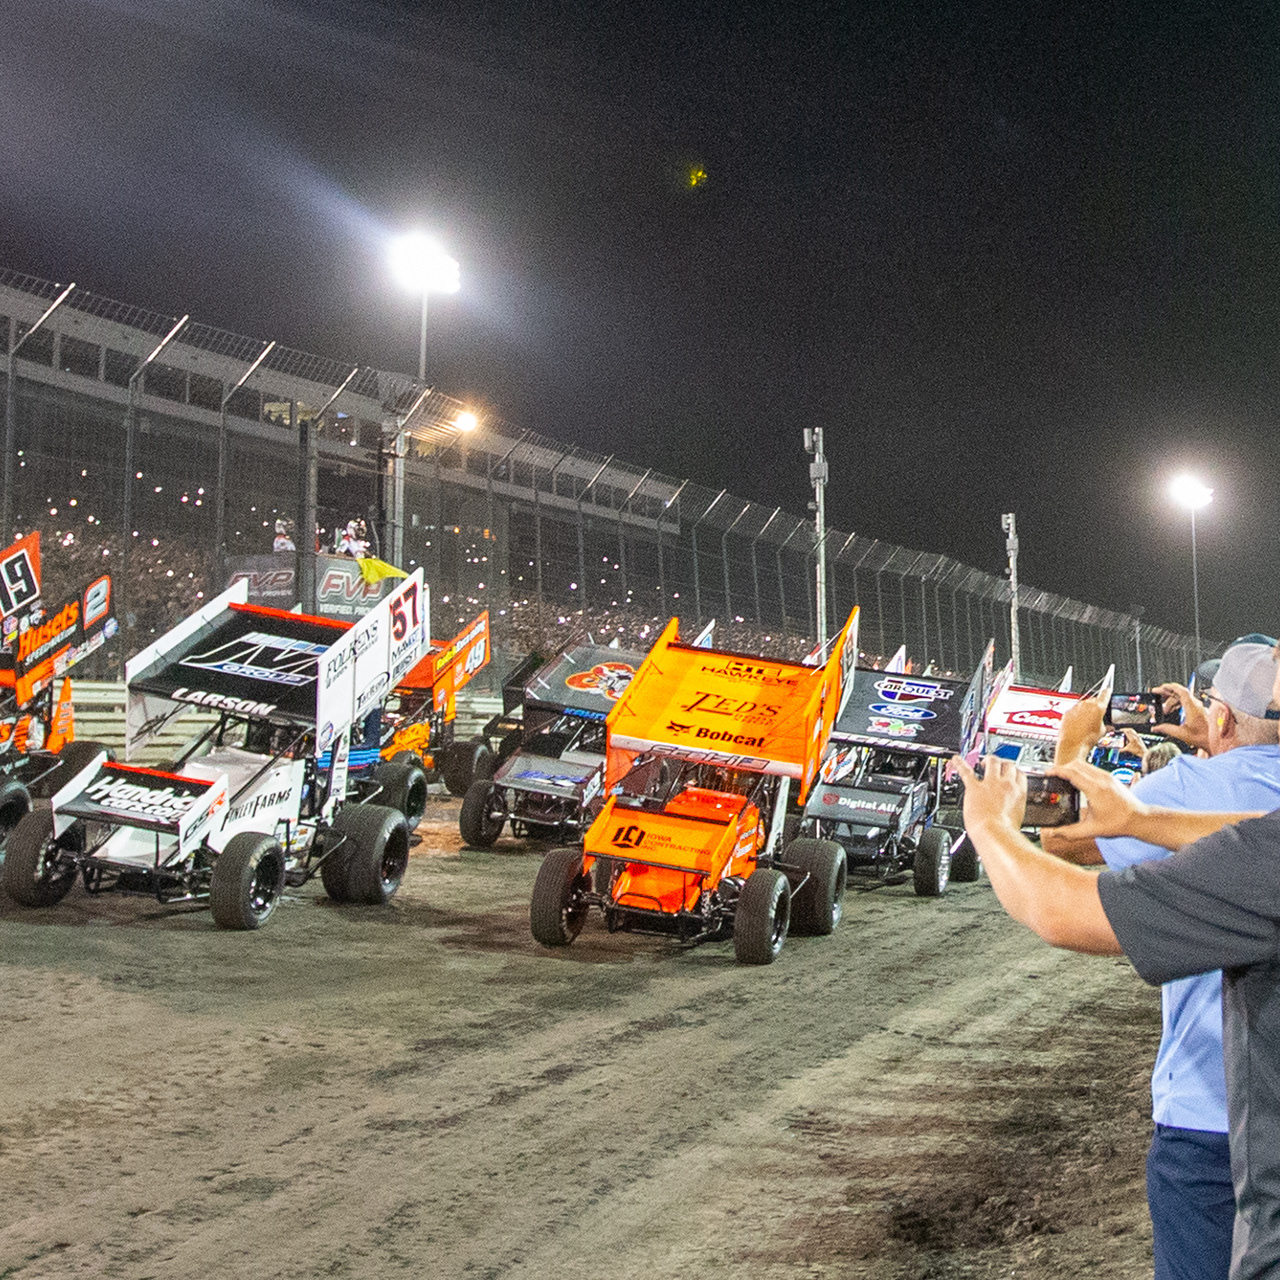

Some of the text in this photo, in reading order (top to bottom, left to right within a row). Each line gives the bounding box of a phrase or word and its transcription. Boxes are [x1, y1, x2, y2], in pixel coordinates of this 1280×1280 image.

[321, 571, 383, 600] FVP
[86, 577, 110, 626] 2
[389, 581, 419, 642] 57
[326, 620, 379, 675] FOLKENS
[466, 638, 487, 674] 49
[221, 663, 307, 684] GROUP
[701, 666, 798, 686] HAWKEYE
[876, 681, 954, 699] CARQUEST
[172, 688, 277, 716] LARSON
[681, 691, 781, 717] TED'S
[880, 705, 925, 719] Ford
[563, 707, 607, 721] KAHN
[696, 728, 765, 748] Bobcat
[220, 787, 292, 832] FINLEY FARMS
[838, 796, 903, 815] Digital Ally
[643, 841, 711, 855] CONTRACTING
[646, 833, 672, 843] IOWA
